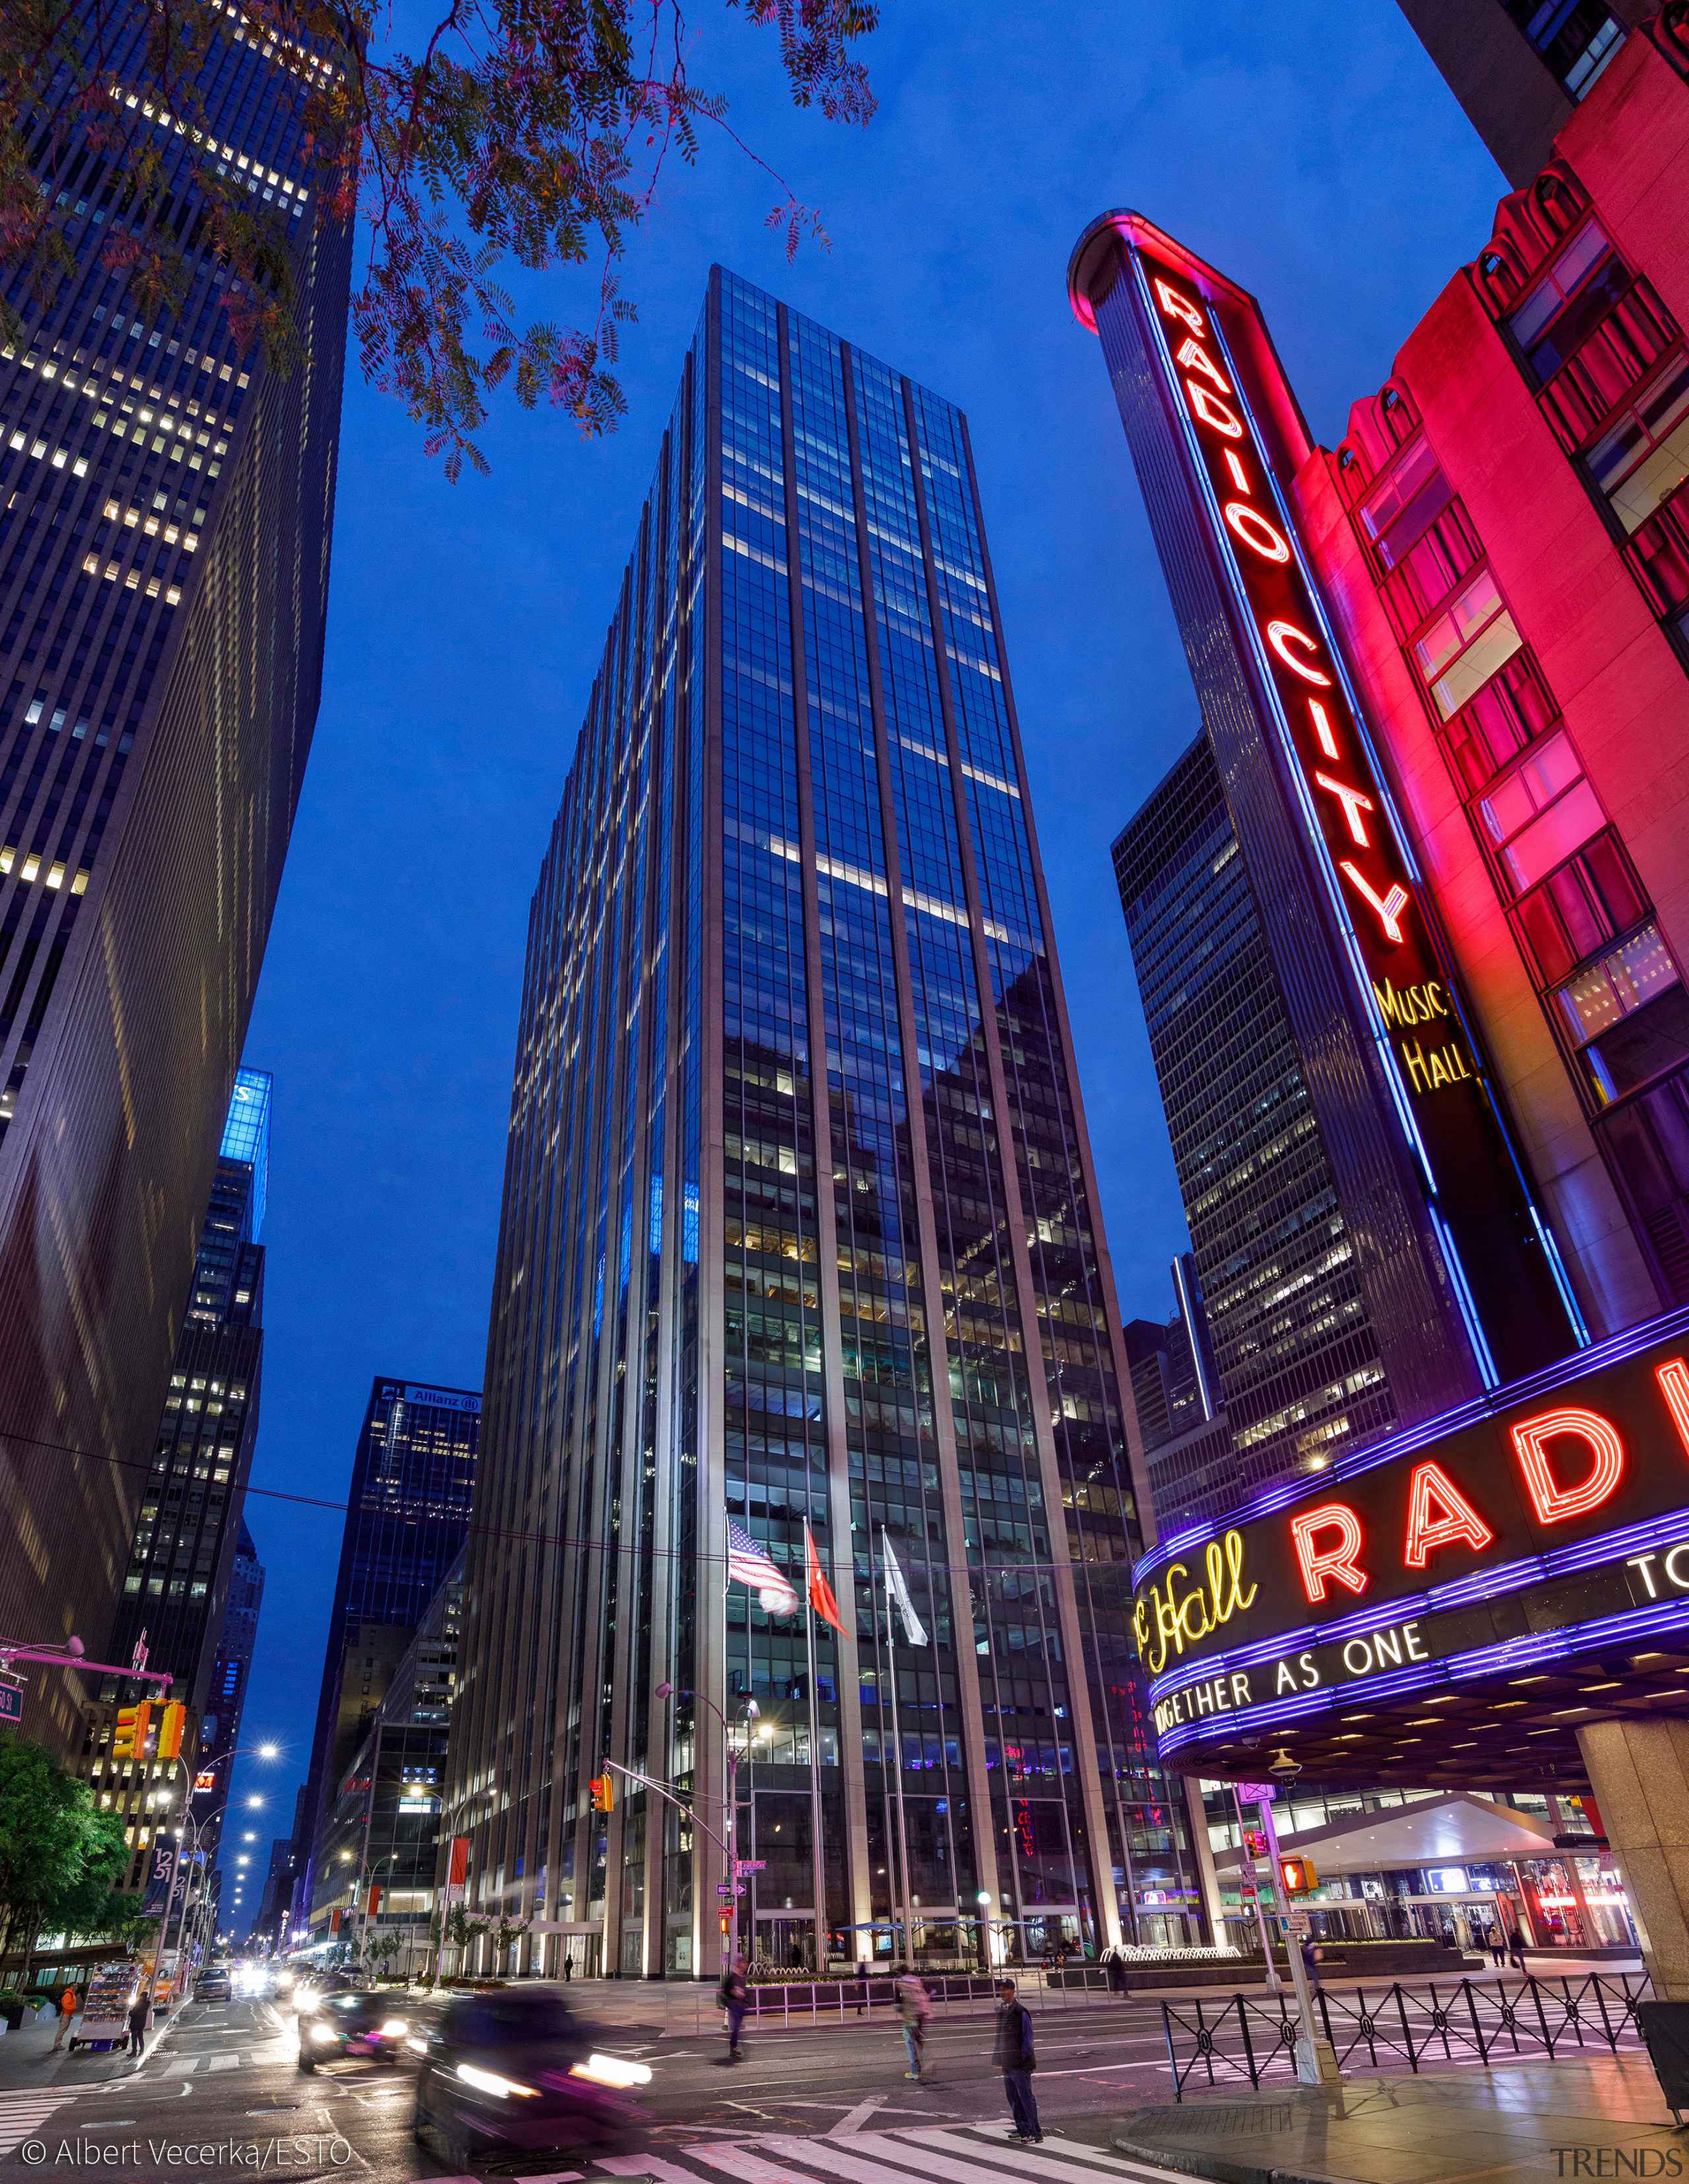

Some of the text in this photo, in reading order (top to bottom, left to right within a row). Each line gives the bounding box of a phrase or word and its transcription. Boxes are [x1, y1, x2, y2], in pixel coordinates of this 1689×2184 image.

[1155, 276, 1410, 944] RADIO CITY
[414, 1390, 459, 1407] Allianz
[1149, 1529, 1258, 1673] Hall
[1155, 1622, 1429, 1737] TOGETHER AS ONE
[153, 1865, 171, 1882] 51
[156, 1848, 174, 1867] 12
